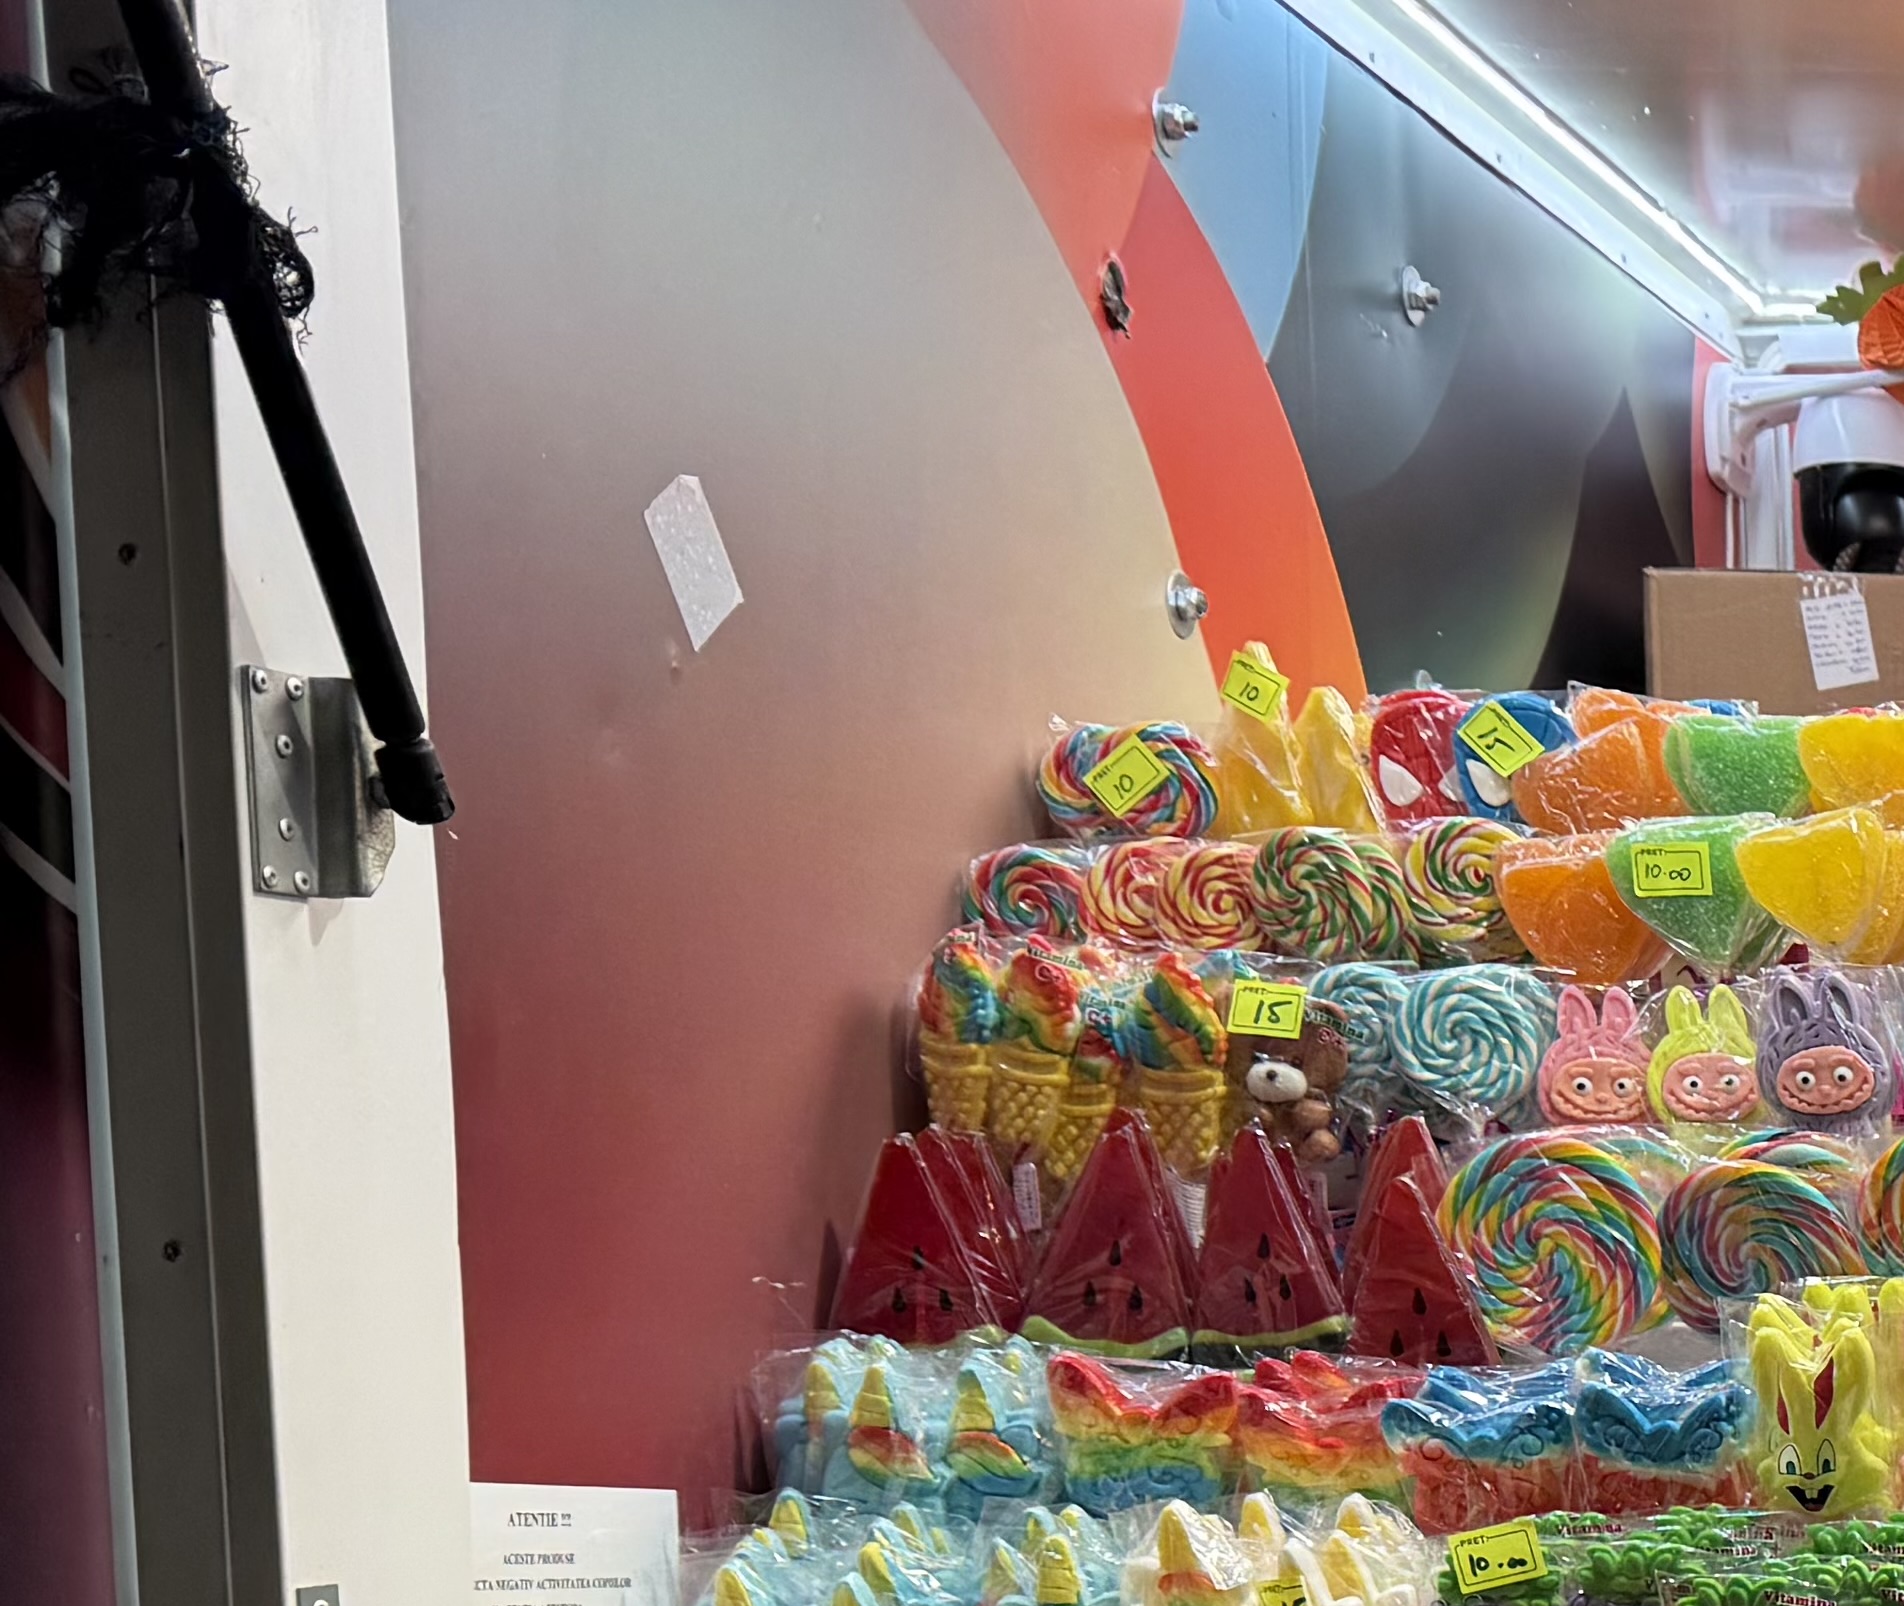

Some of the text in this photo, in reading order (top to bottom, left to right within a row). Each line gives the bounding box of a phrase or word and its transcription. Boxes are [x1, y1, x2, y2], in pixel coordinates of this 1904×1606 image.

[1240, 682, 1259, 701] 10
[1113, 776, 1134, 797] 10
[1645, 863, 1691, 881] 10.00
[1252, 1000, 1292, 1024] 15
[507, 1512, 559, 1528] ATENTIE
